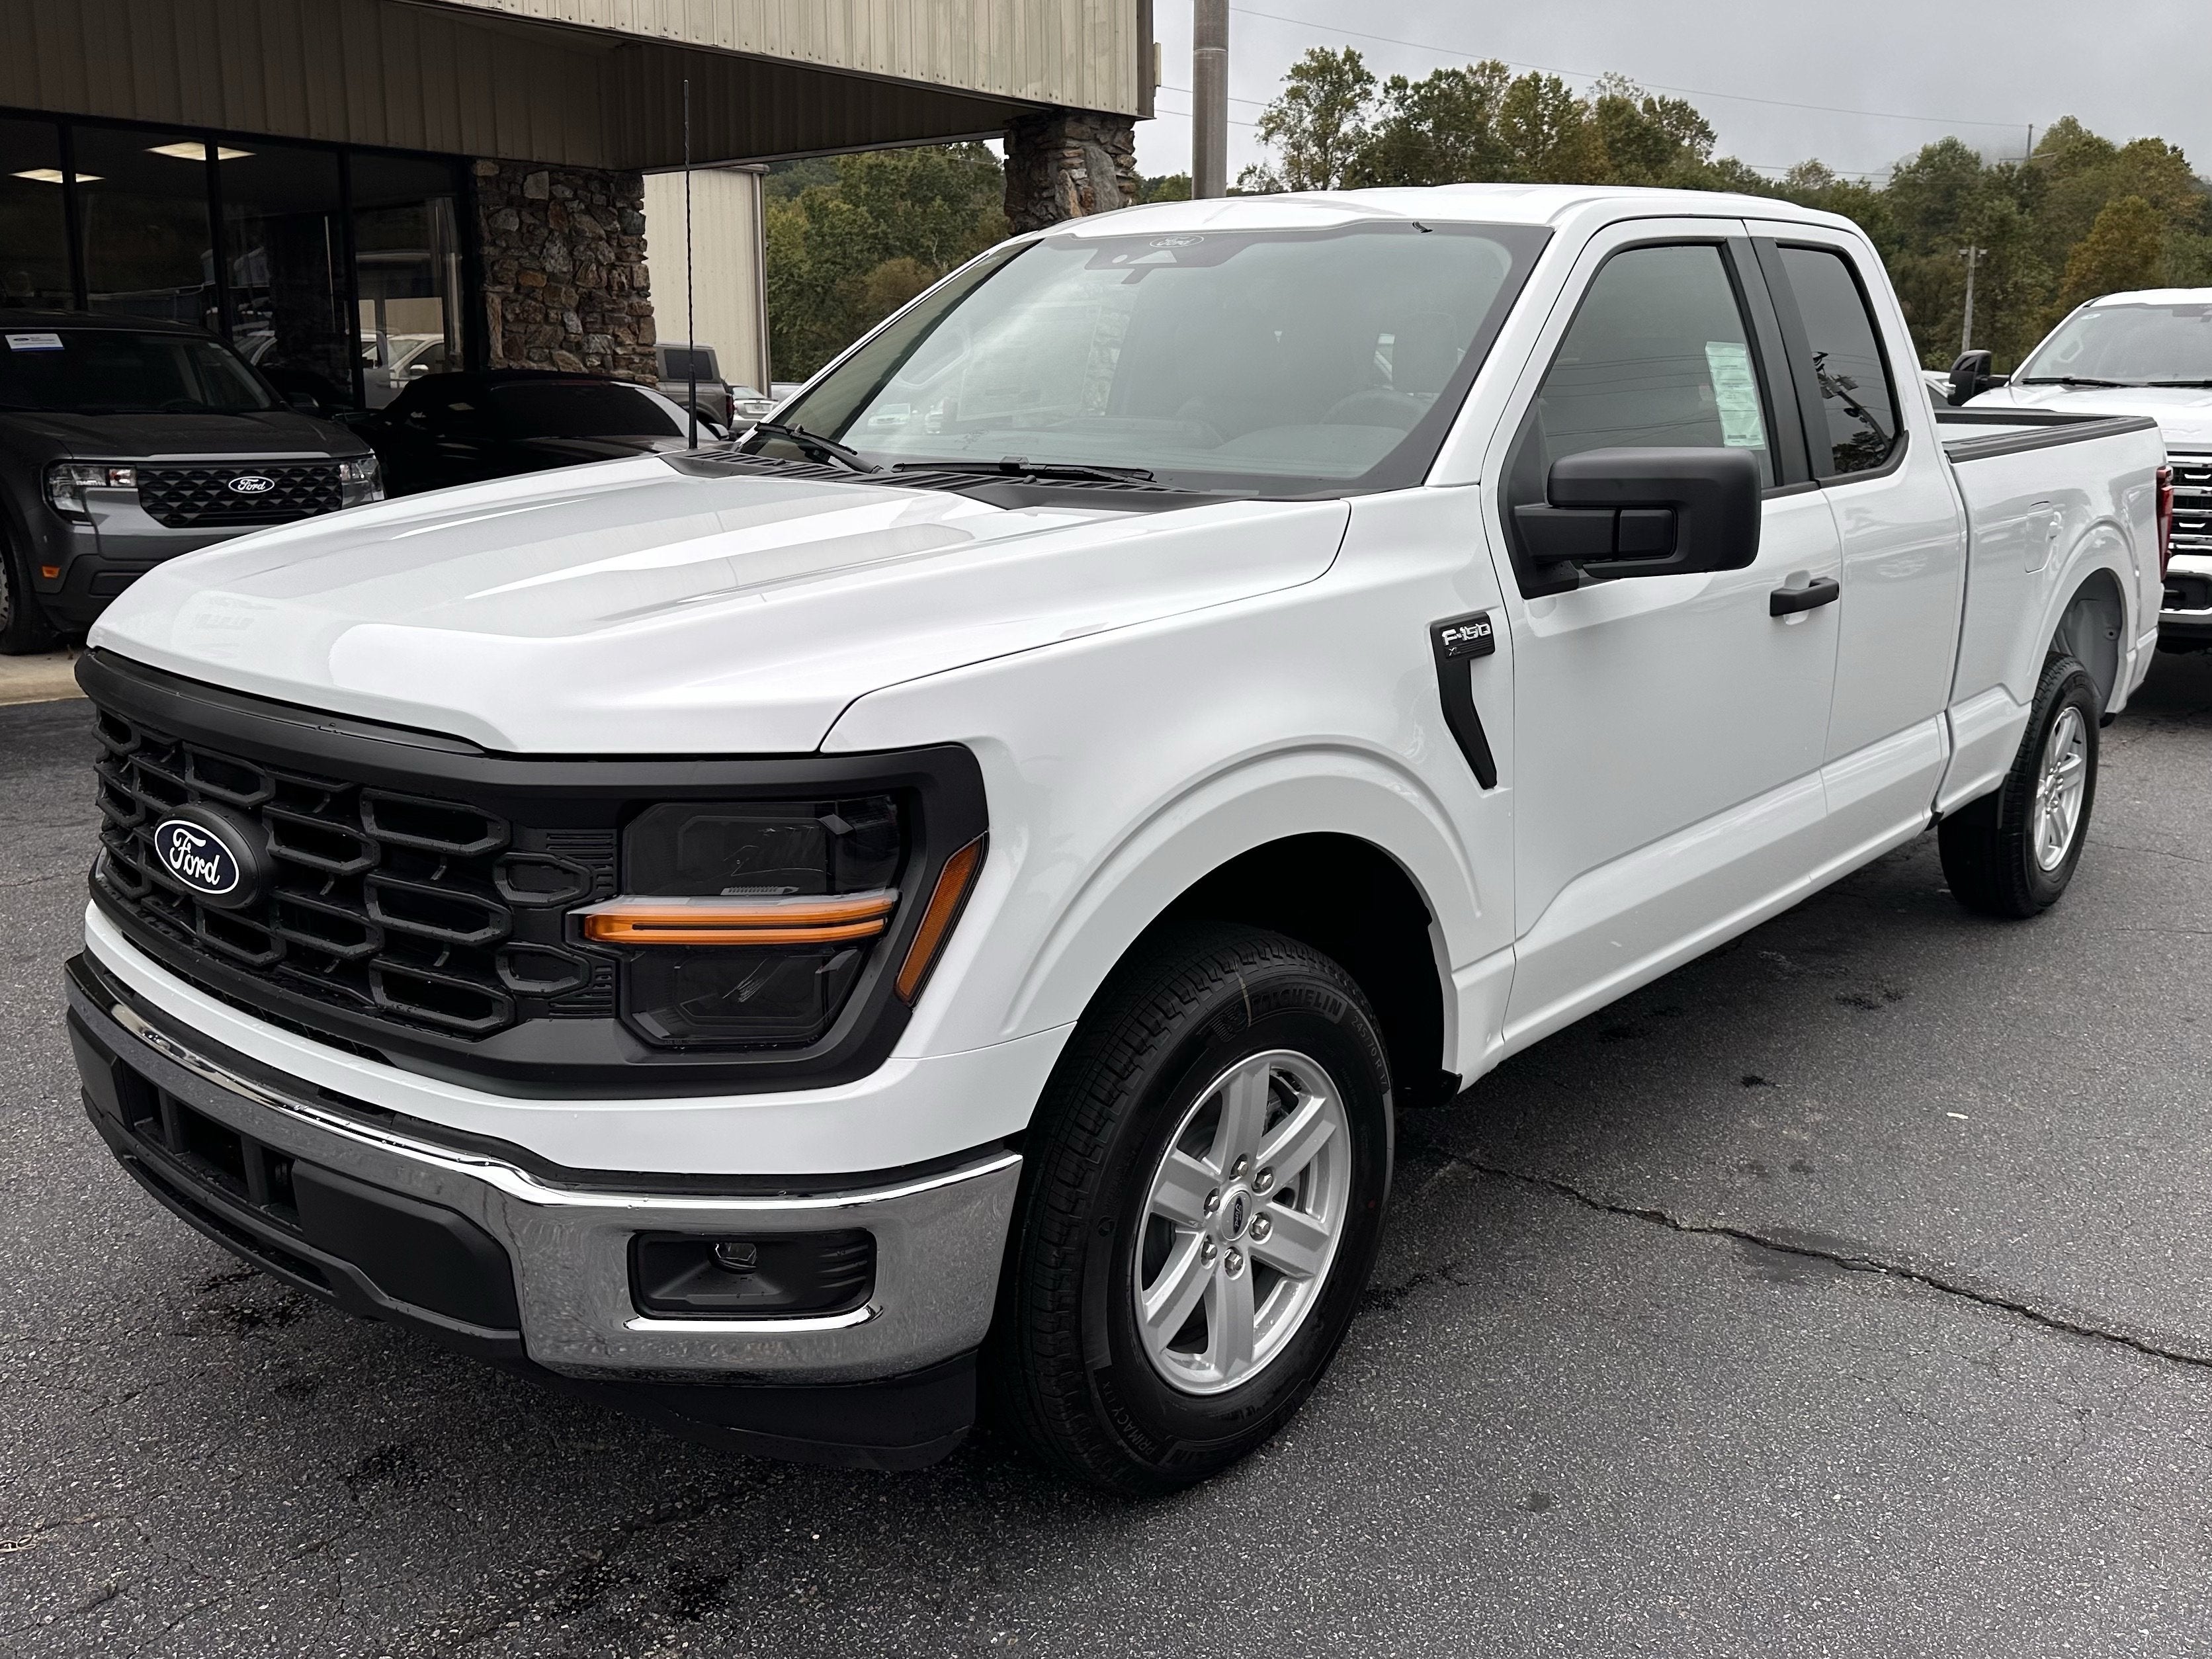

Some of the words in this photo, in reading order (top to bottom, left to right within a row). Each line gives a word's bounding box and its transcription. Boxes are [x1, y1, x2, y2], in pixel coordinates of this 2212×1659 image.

[1156, 237, 1196, 245] Ford
[237, 479, 266, 490] Ford
[1442, 623, 1492, 646] F-150
[169, 828, 220, 886] Ford
[1112, 1407, 1156, 1455] PRIMACY
